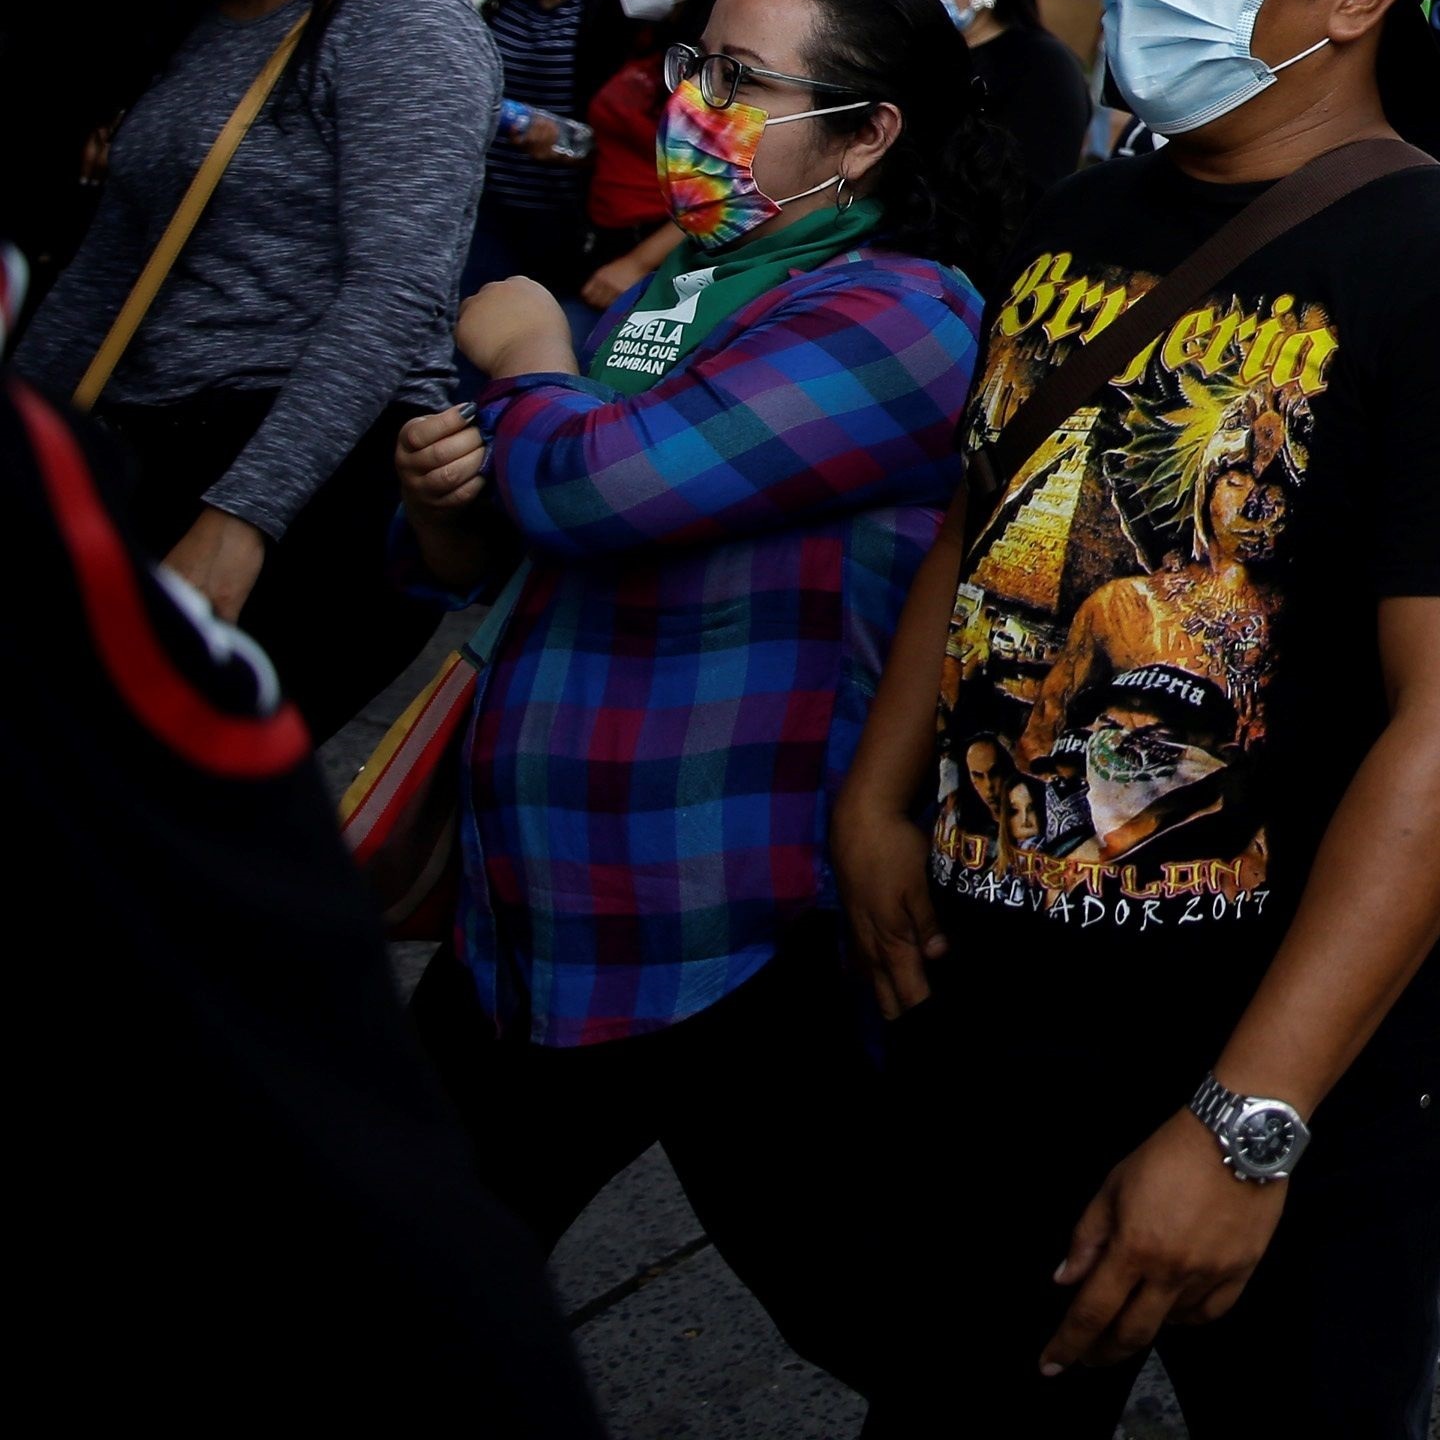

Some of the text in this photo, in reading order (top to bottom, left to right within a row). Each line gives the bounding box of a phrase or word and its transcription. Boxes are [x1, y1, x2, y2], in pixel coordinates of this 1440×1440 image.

[649, 344, 680, 361] QUE
[606, 354, 665, 375] CAMBIAN
[956, 868, 1165, 932] SALVADOR
[1177, 890, 1271, 925] 2017
